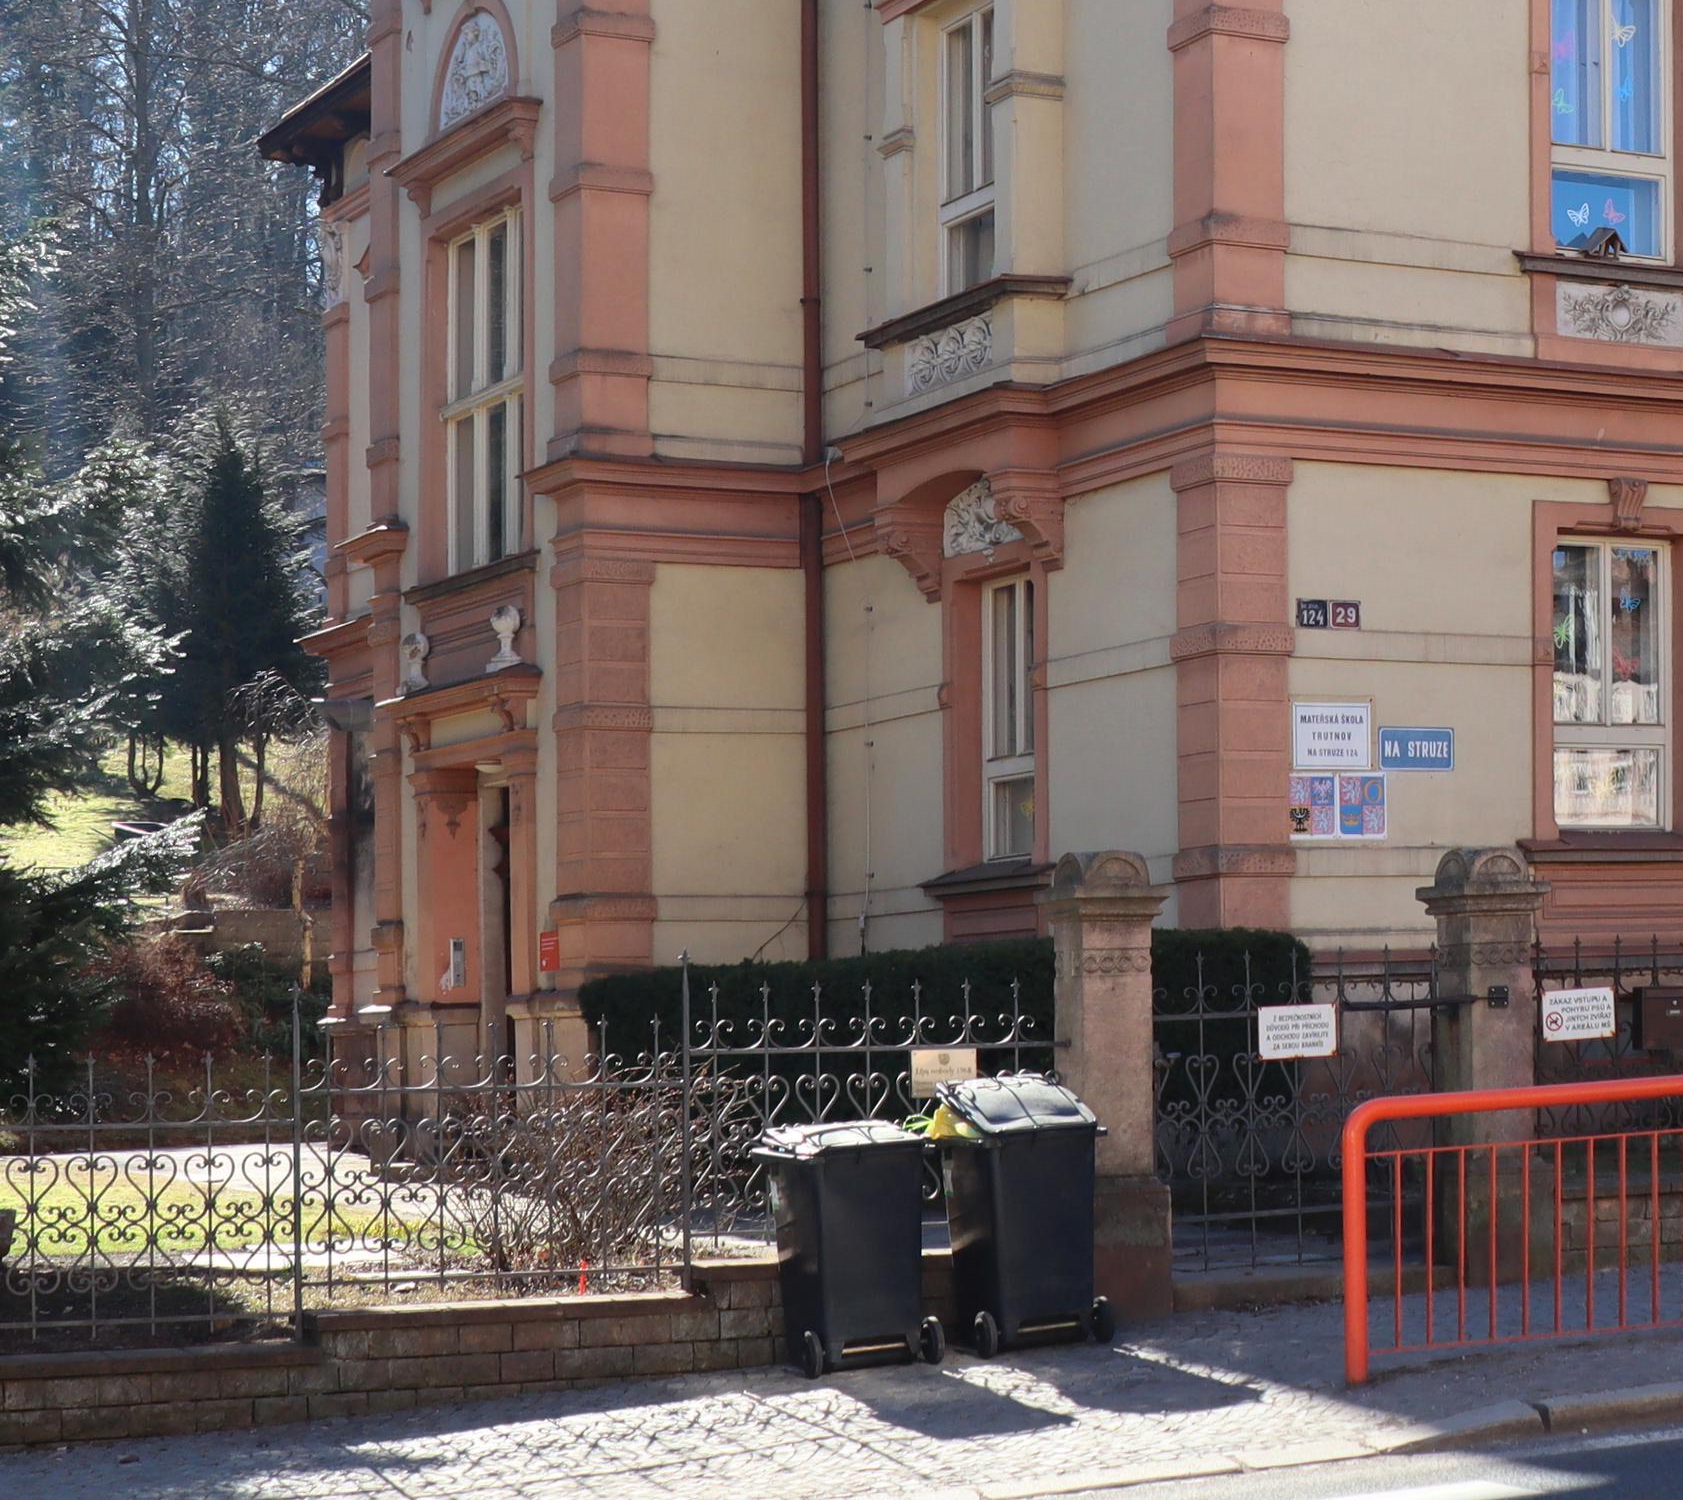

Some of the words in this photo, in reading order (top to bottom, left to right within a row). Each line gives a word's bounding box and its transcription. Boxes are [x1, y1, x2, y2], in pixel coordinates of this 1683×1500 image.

[1302, 609, 1324, 626] 124
[1335, 606, 1357, 624] 29
[1300, 713, 1339, 724] MATEŘSKÁ
[1341, 714, 1364, 724] ŠKOLA
[1312, 731, 1352, 741] TRUTNOV
[1307, 748, 1317, 757] NA
[1319, 748, 1344, 757] STRUZE
[1346, 748, 1358, 757] 124
[1384, 740, 1401, 758] NA
[1407, 740, 1449, 758] STRUZE
[1549, 997, 1572, 1005] ZÁKAZ
[1573, 995, 1601, 1004] VSTUPU
[1571, 1022, 1599, 1031] AREÁLU
